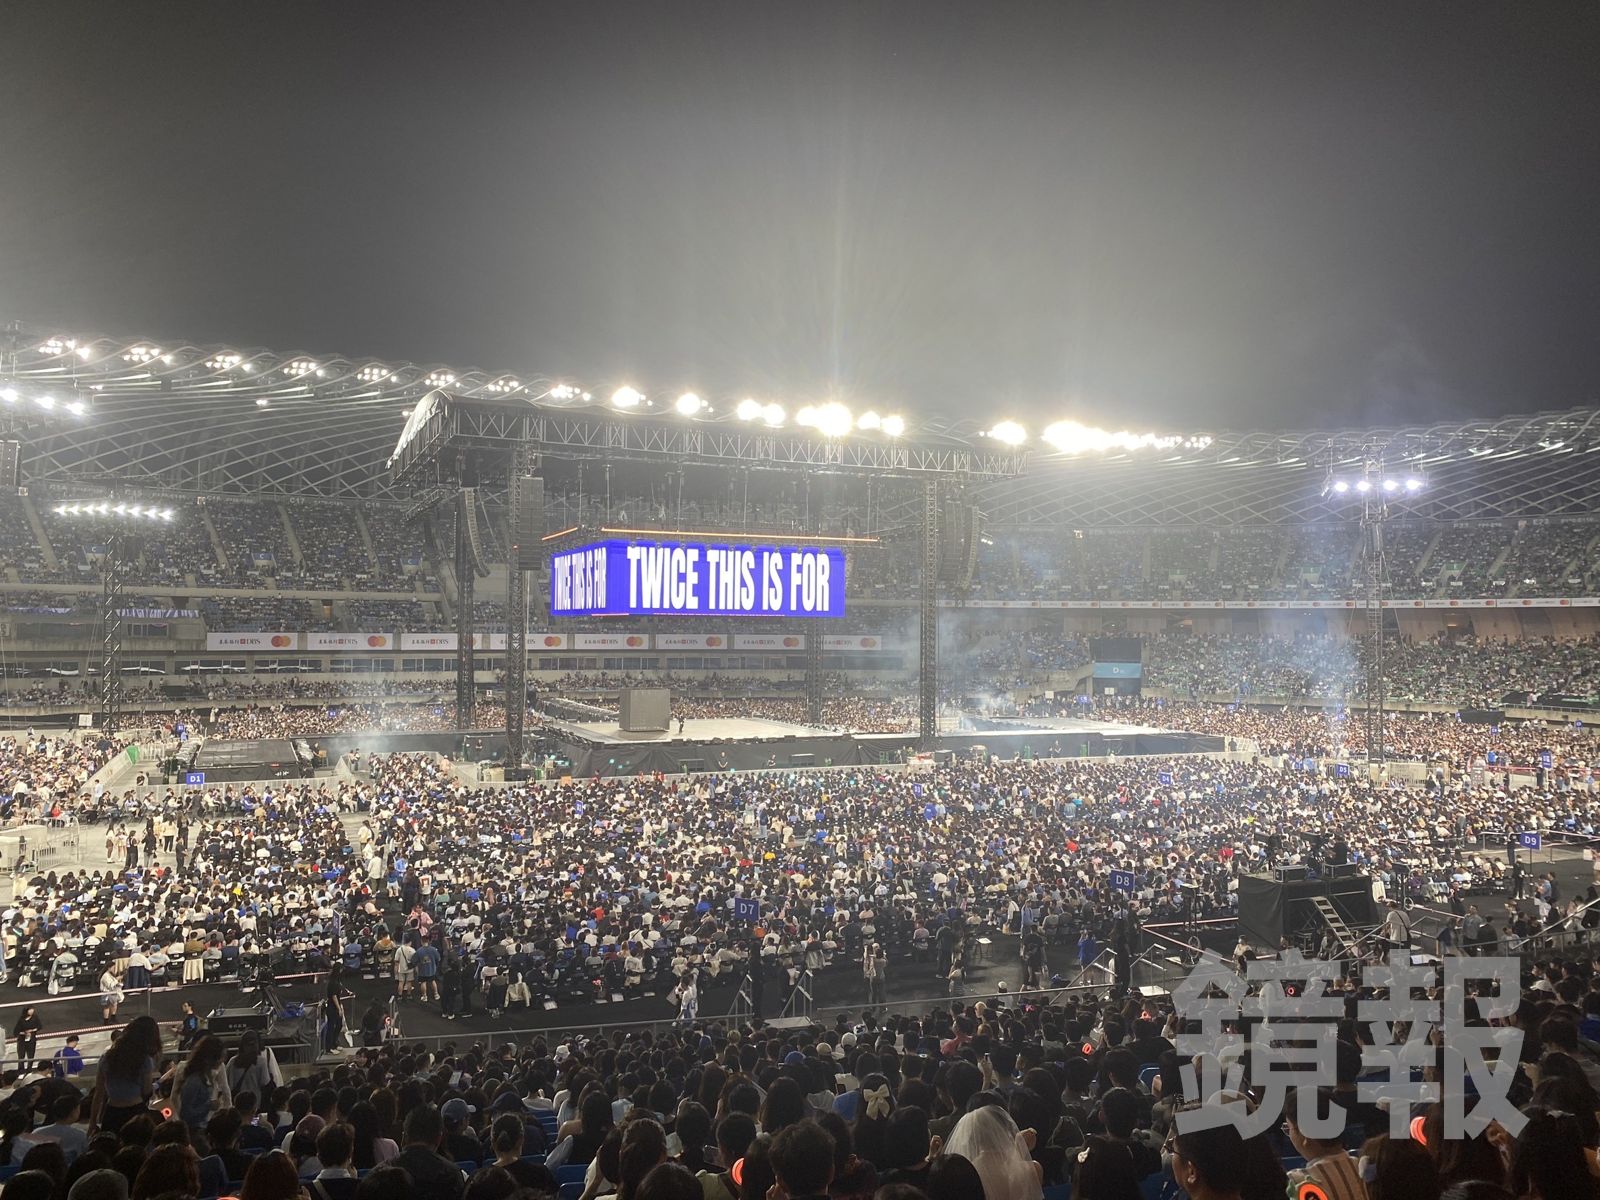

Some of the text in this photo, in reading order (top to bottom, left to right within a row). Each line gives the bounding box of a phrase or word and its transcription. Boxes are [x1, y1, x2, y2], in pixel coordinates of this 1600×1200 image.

[626, 546, 830, 611] TWICE THIS IS FOR
[190, 775, 201, 783] D1
[1525, 835, 1537, 846] D9
[1116, 875, 1130, 887] D8
[740, 902, 755, 915] D7
